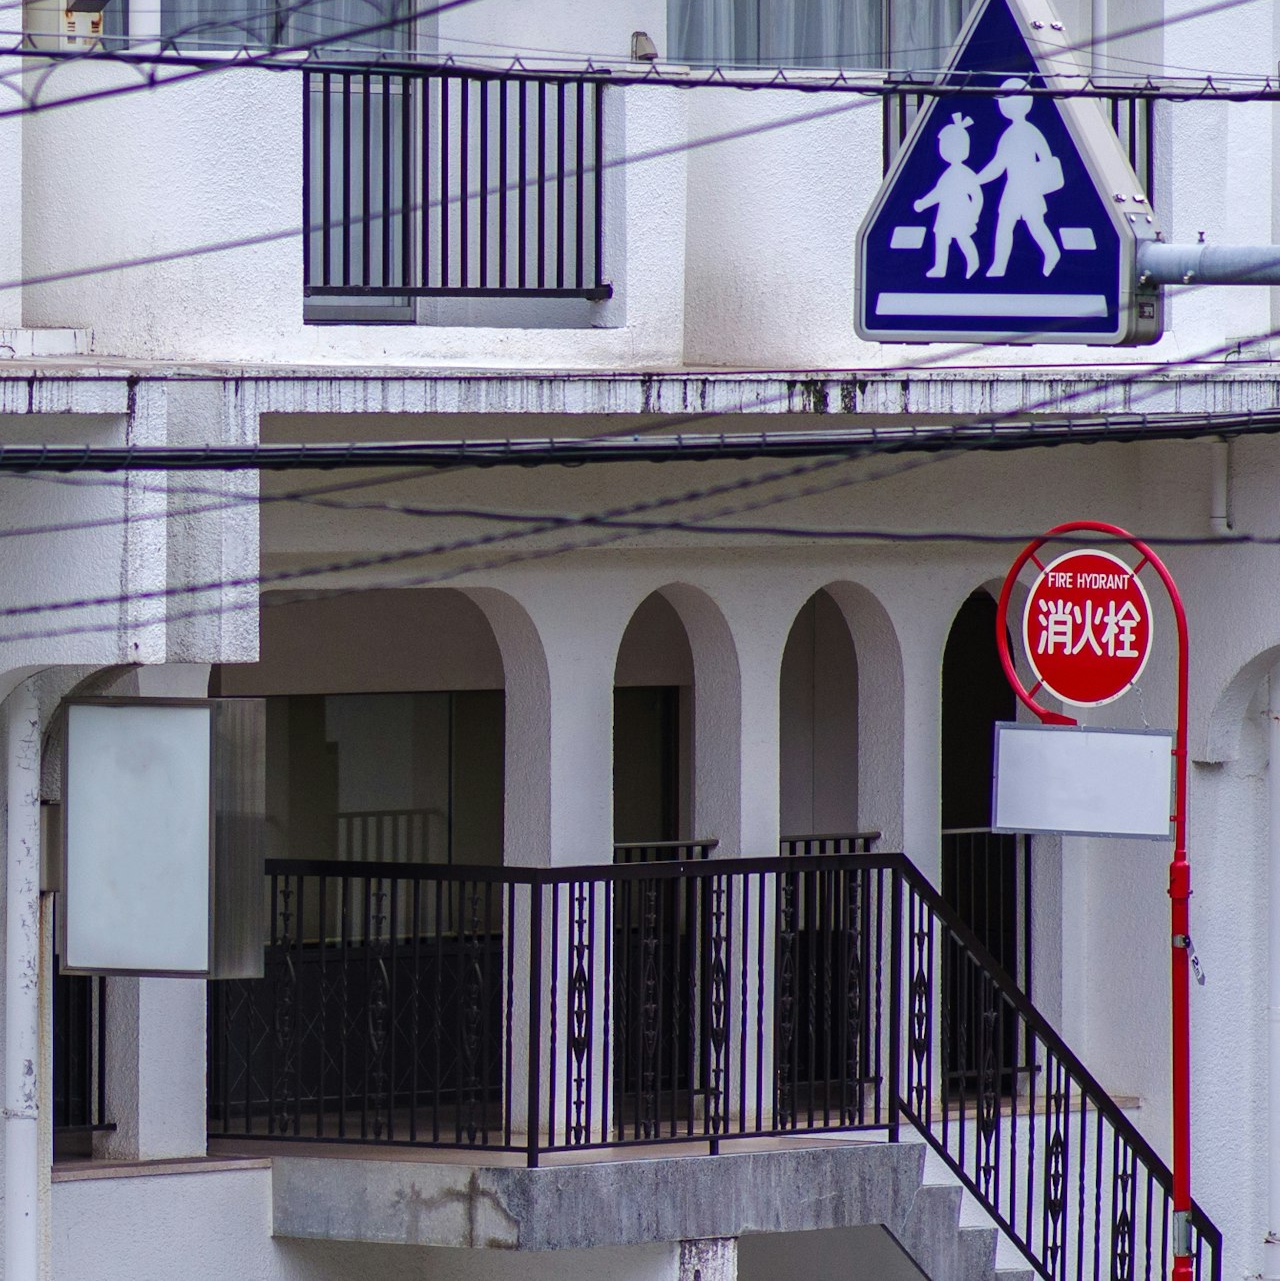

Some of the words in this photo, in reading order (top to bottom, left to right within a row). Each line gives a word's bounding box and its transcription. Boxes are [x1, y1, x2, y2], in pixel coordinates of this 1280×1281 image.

[1048, 572, 1073, 588] FIRE
[1077, 573, 1130, 590] HYDRANT
[1037, 599, 1141, 658] 消火栓
